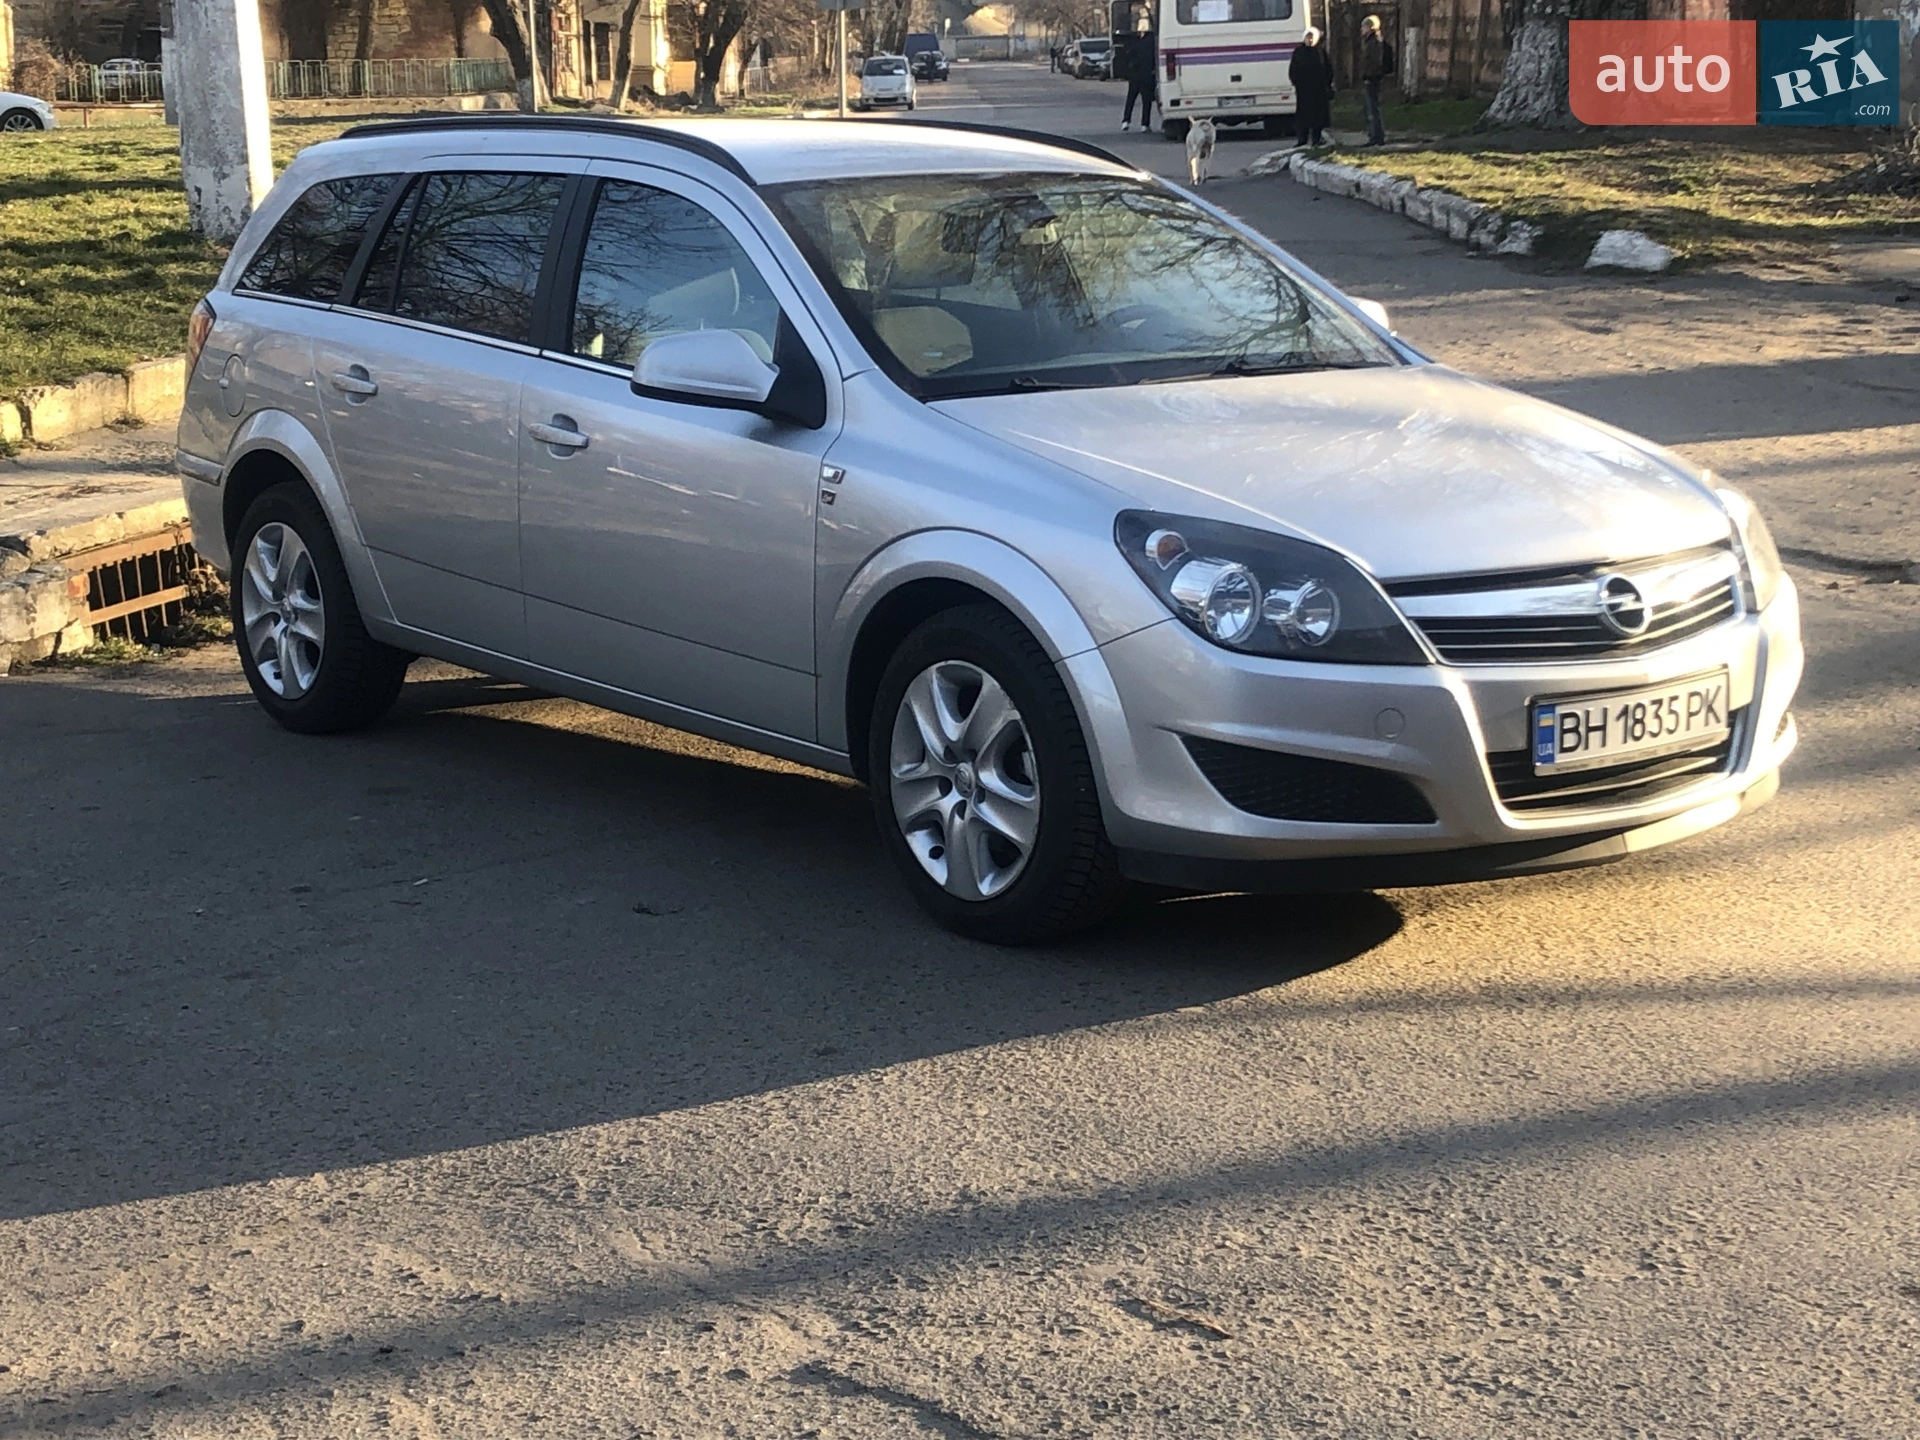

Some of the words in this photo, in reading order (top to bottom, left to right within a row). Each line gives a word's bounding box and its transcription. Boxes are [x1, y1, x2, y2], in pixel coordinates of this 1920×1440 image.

[1558, 707, 1608, 754] BH
[1615, 695, 1680, 745] 1835
[1685, 685, 1722, 731] PK
[1537, 742, 1554, 756] UA
